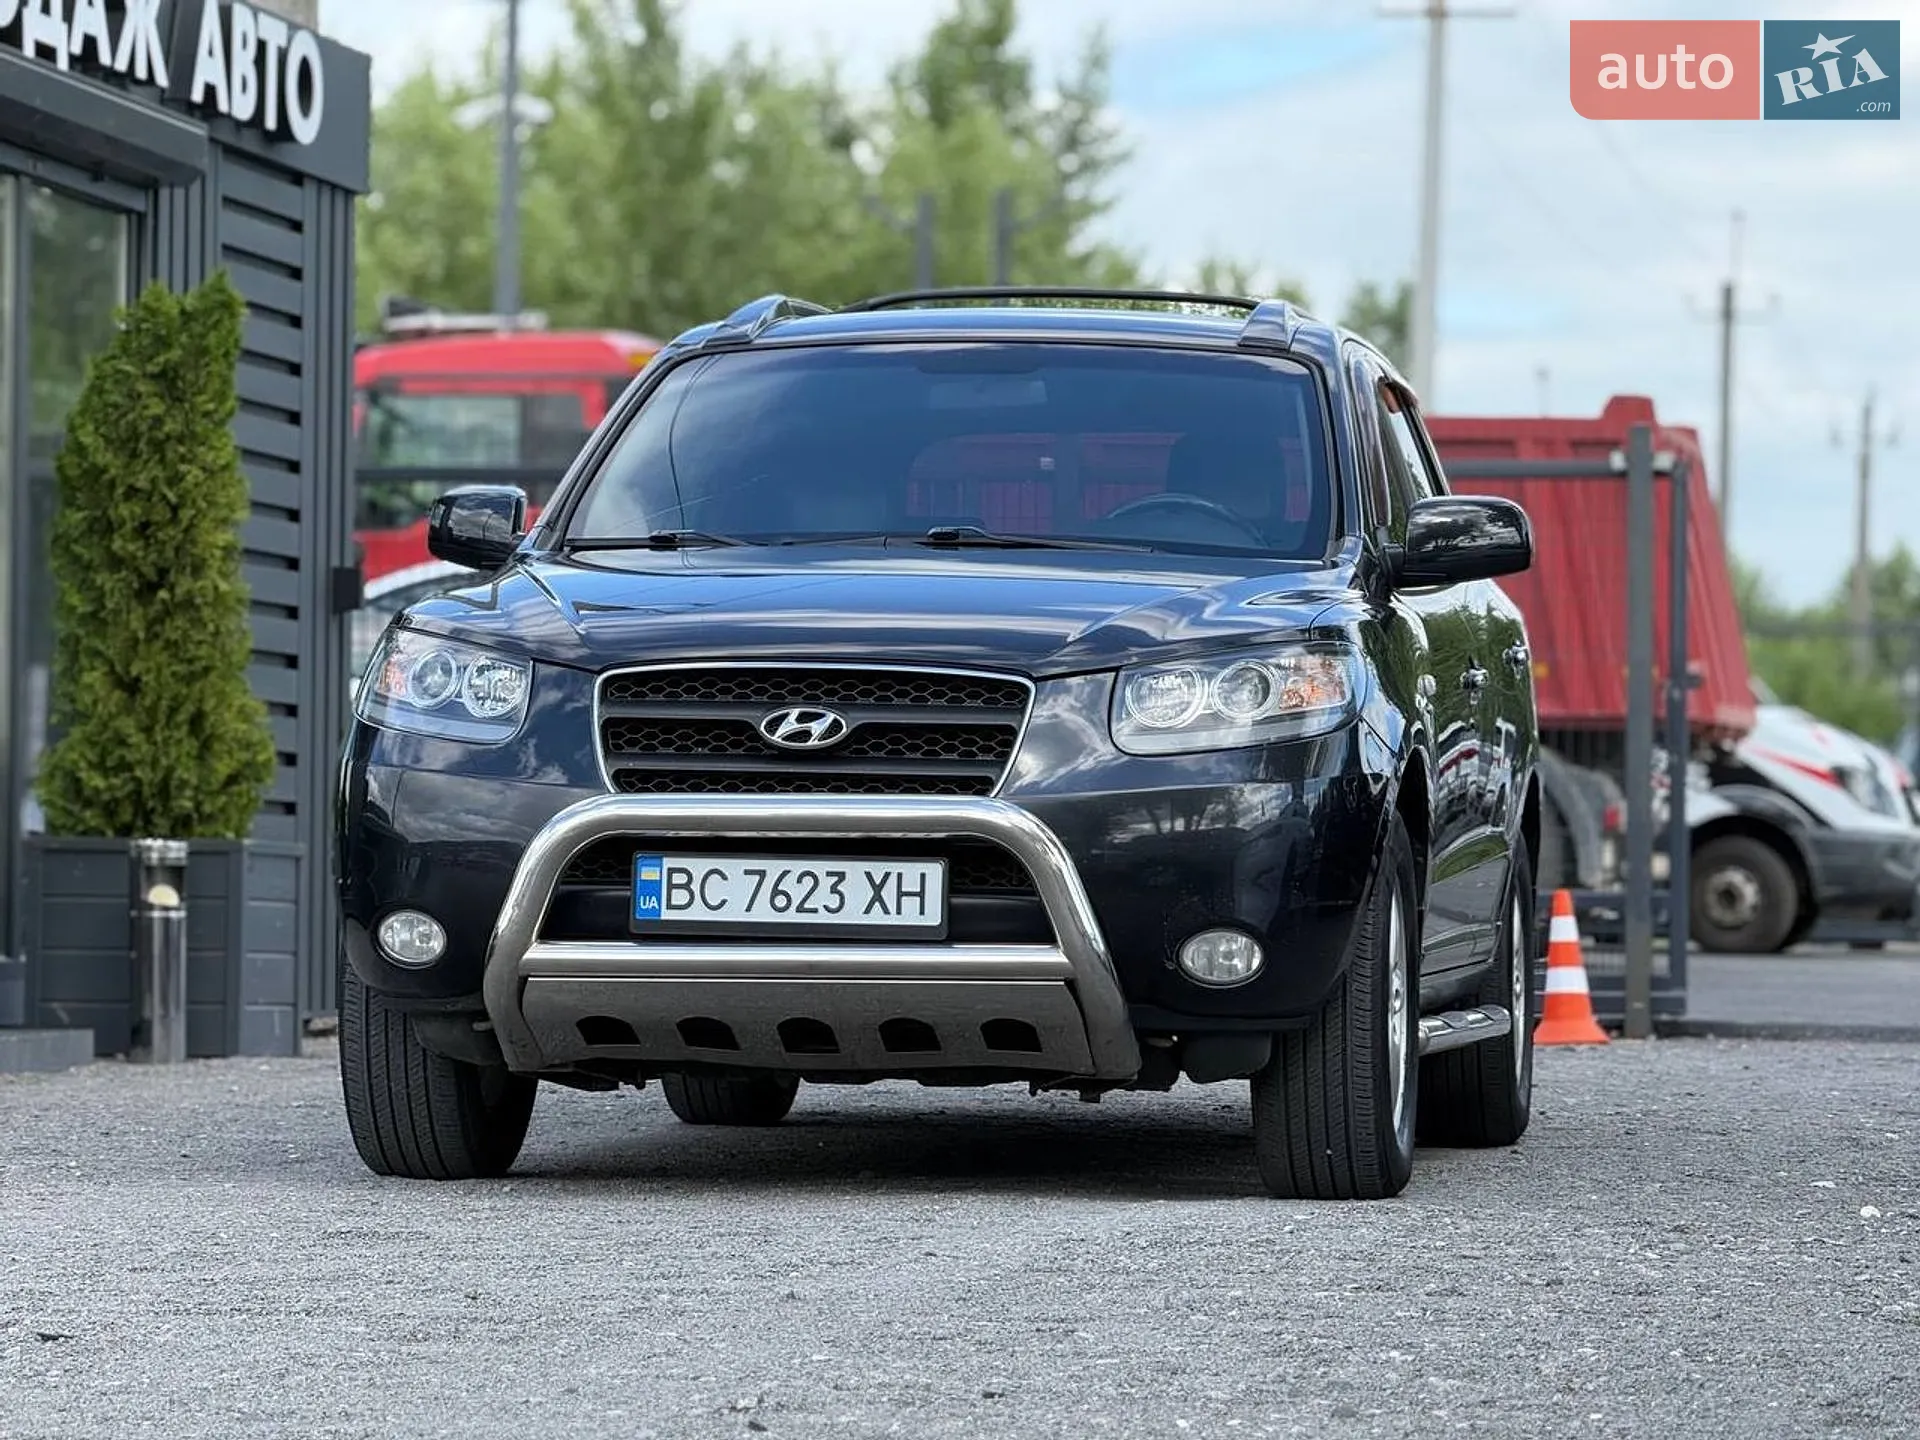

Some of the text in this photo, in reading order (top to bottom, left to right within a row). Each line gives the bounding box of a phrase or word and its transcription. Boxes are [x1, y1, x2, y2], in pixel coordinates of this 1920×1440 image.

[0, 0, 324, 145] ДАЖ АВТО
[640, 894, 660, 910] UA
[665, 866, 927, 917] BC 7623 XH
